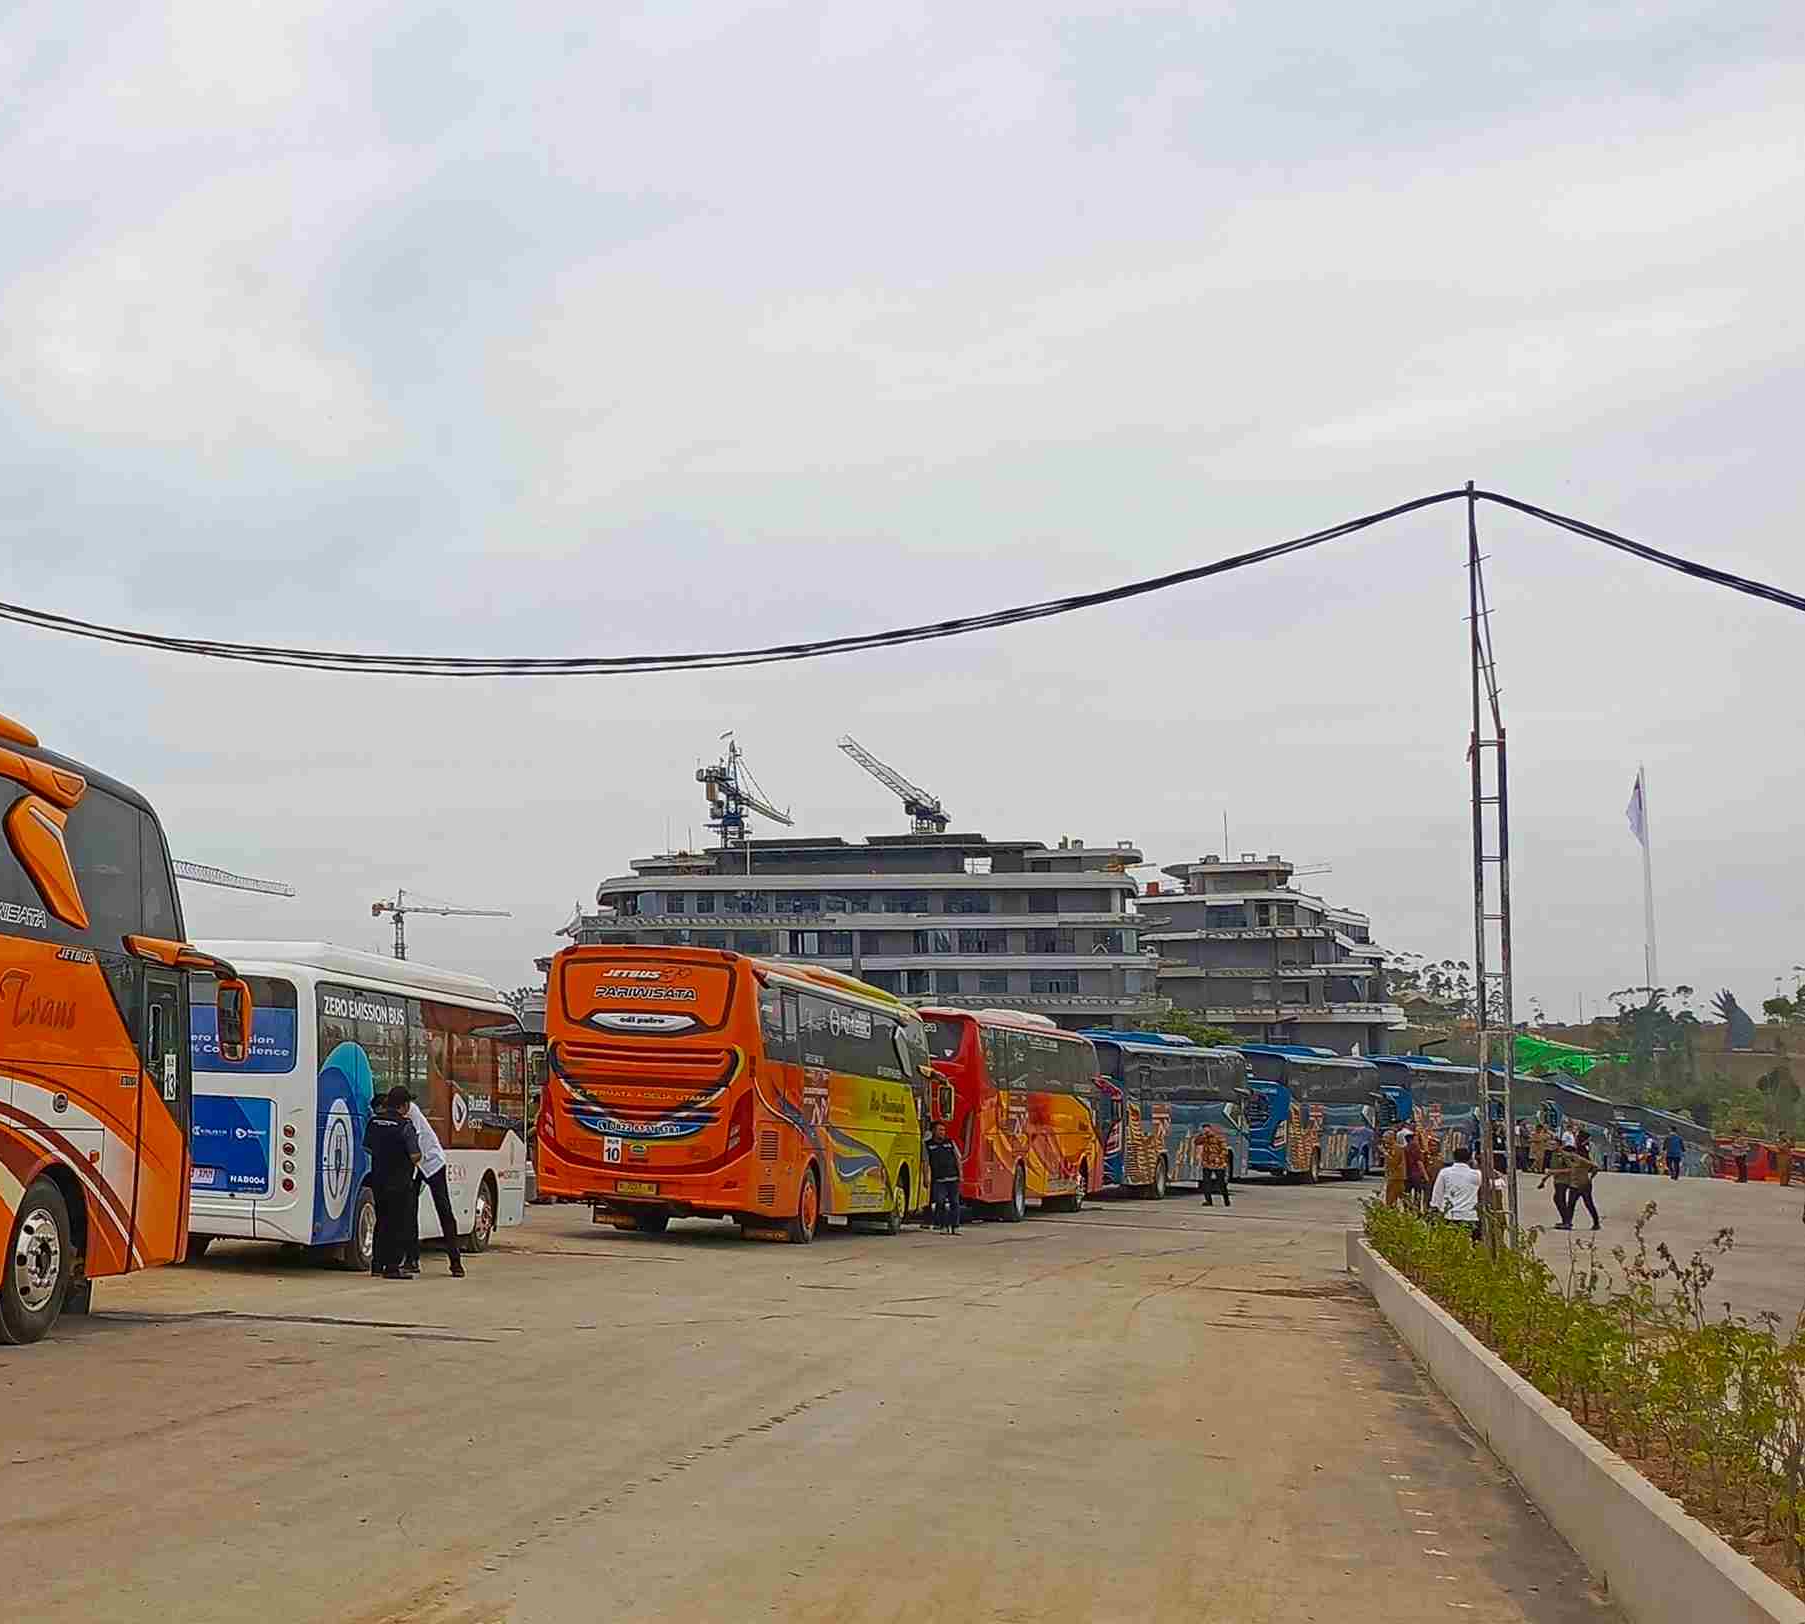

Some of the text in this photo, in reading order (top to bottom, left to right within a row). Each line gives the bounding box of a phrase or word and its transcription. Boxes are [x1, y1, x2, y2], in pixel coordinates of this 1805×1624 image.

[594, 985, 698, 1001] PARIWISATA
[323, 995, 405, 1025] ZERO EMISSION BUS
[605, 1146, 621, 1161] 10
